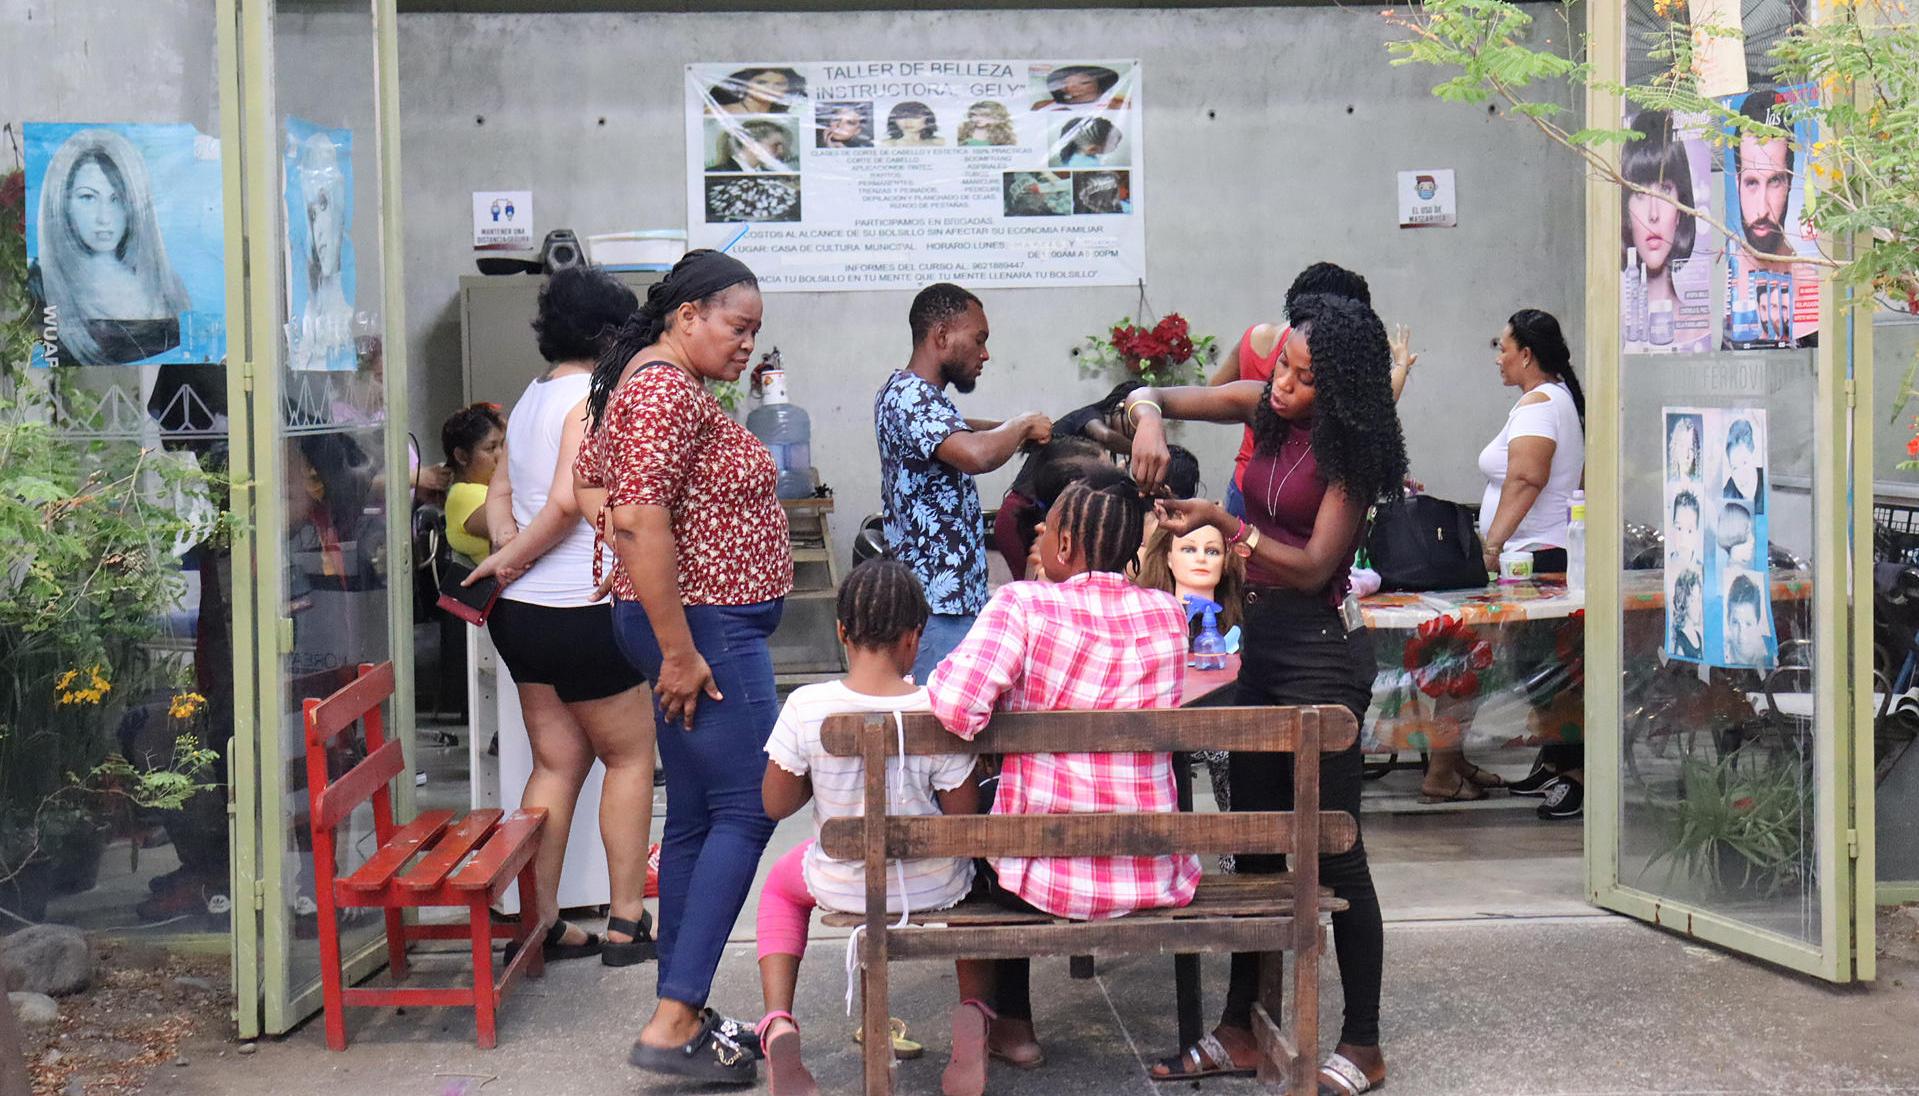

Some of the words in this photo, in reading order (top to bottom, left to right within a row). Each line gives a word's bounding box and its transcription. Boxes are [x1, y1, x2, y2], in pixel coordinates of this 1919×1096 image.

[823, 63, 894, 80] TALLER
[899, 62, 925, 76] DE
[930, 62, 1014, 78] BELLEZA
[891, 148, 925, 156] CABELLO
[854, 218, 925, 226] PARTICIPAMOS
[744, 230, 784, 239] COSTOS
[785, 230, 797, 238] AL
[799, 230, 842, 238] ALCANCE
[845, 229, 858, 237] DE
[863, 229, 876, 237] SU
[878, 228, 925, 237] BOLSILLO
[927, 228, 943, 236] SIN
[944, 227, 990, 235] AFECTAR
[991, 227, 1005, 235] SU
[1007, 226, 1059, 235] ECONOMIA
[1060, 225, 1104, 234] FAMILIAR
[770, 244, 798, 252] CASA
[799, 243, 813, 252] DE
[815, 243, 861, 252] CULTURA
[926, 241, 971, 250] HORARIO
[1027, 250, 1040, 259] DE
[844, 263, 895, 272] INFORMES
[897, 263, 914, 271] DEL
[918, 263, 953, 271] CURSO
[784, 275, 797, 284] TU
[798, 274, 846, 283] BOLSILLO
[847, 274, 862, 283] EN
[864, 273, 877, 282] TU
[879, 273, 912, 282] MENTE
[914, 272, 935, 282] QUE
[938, 272, 951, 281] TU
[953, 271, 985, 280] MENTE
[988, 270, 1033, 280] LLENARA
[1035, 270, 1048, 279] TU
